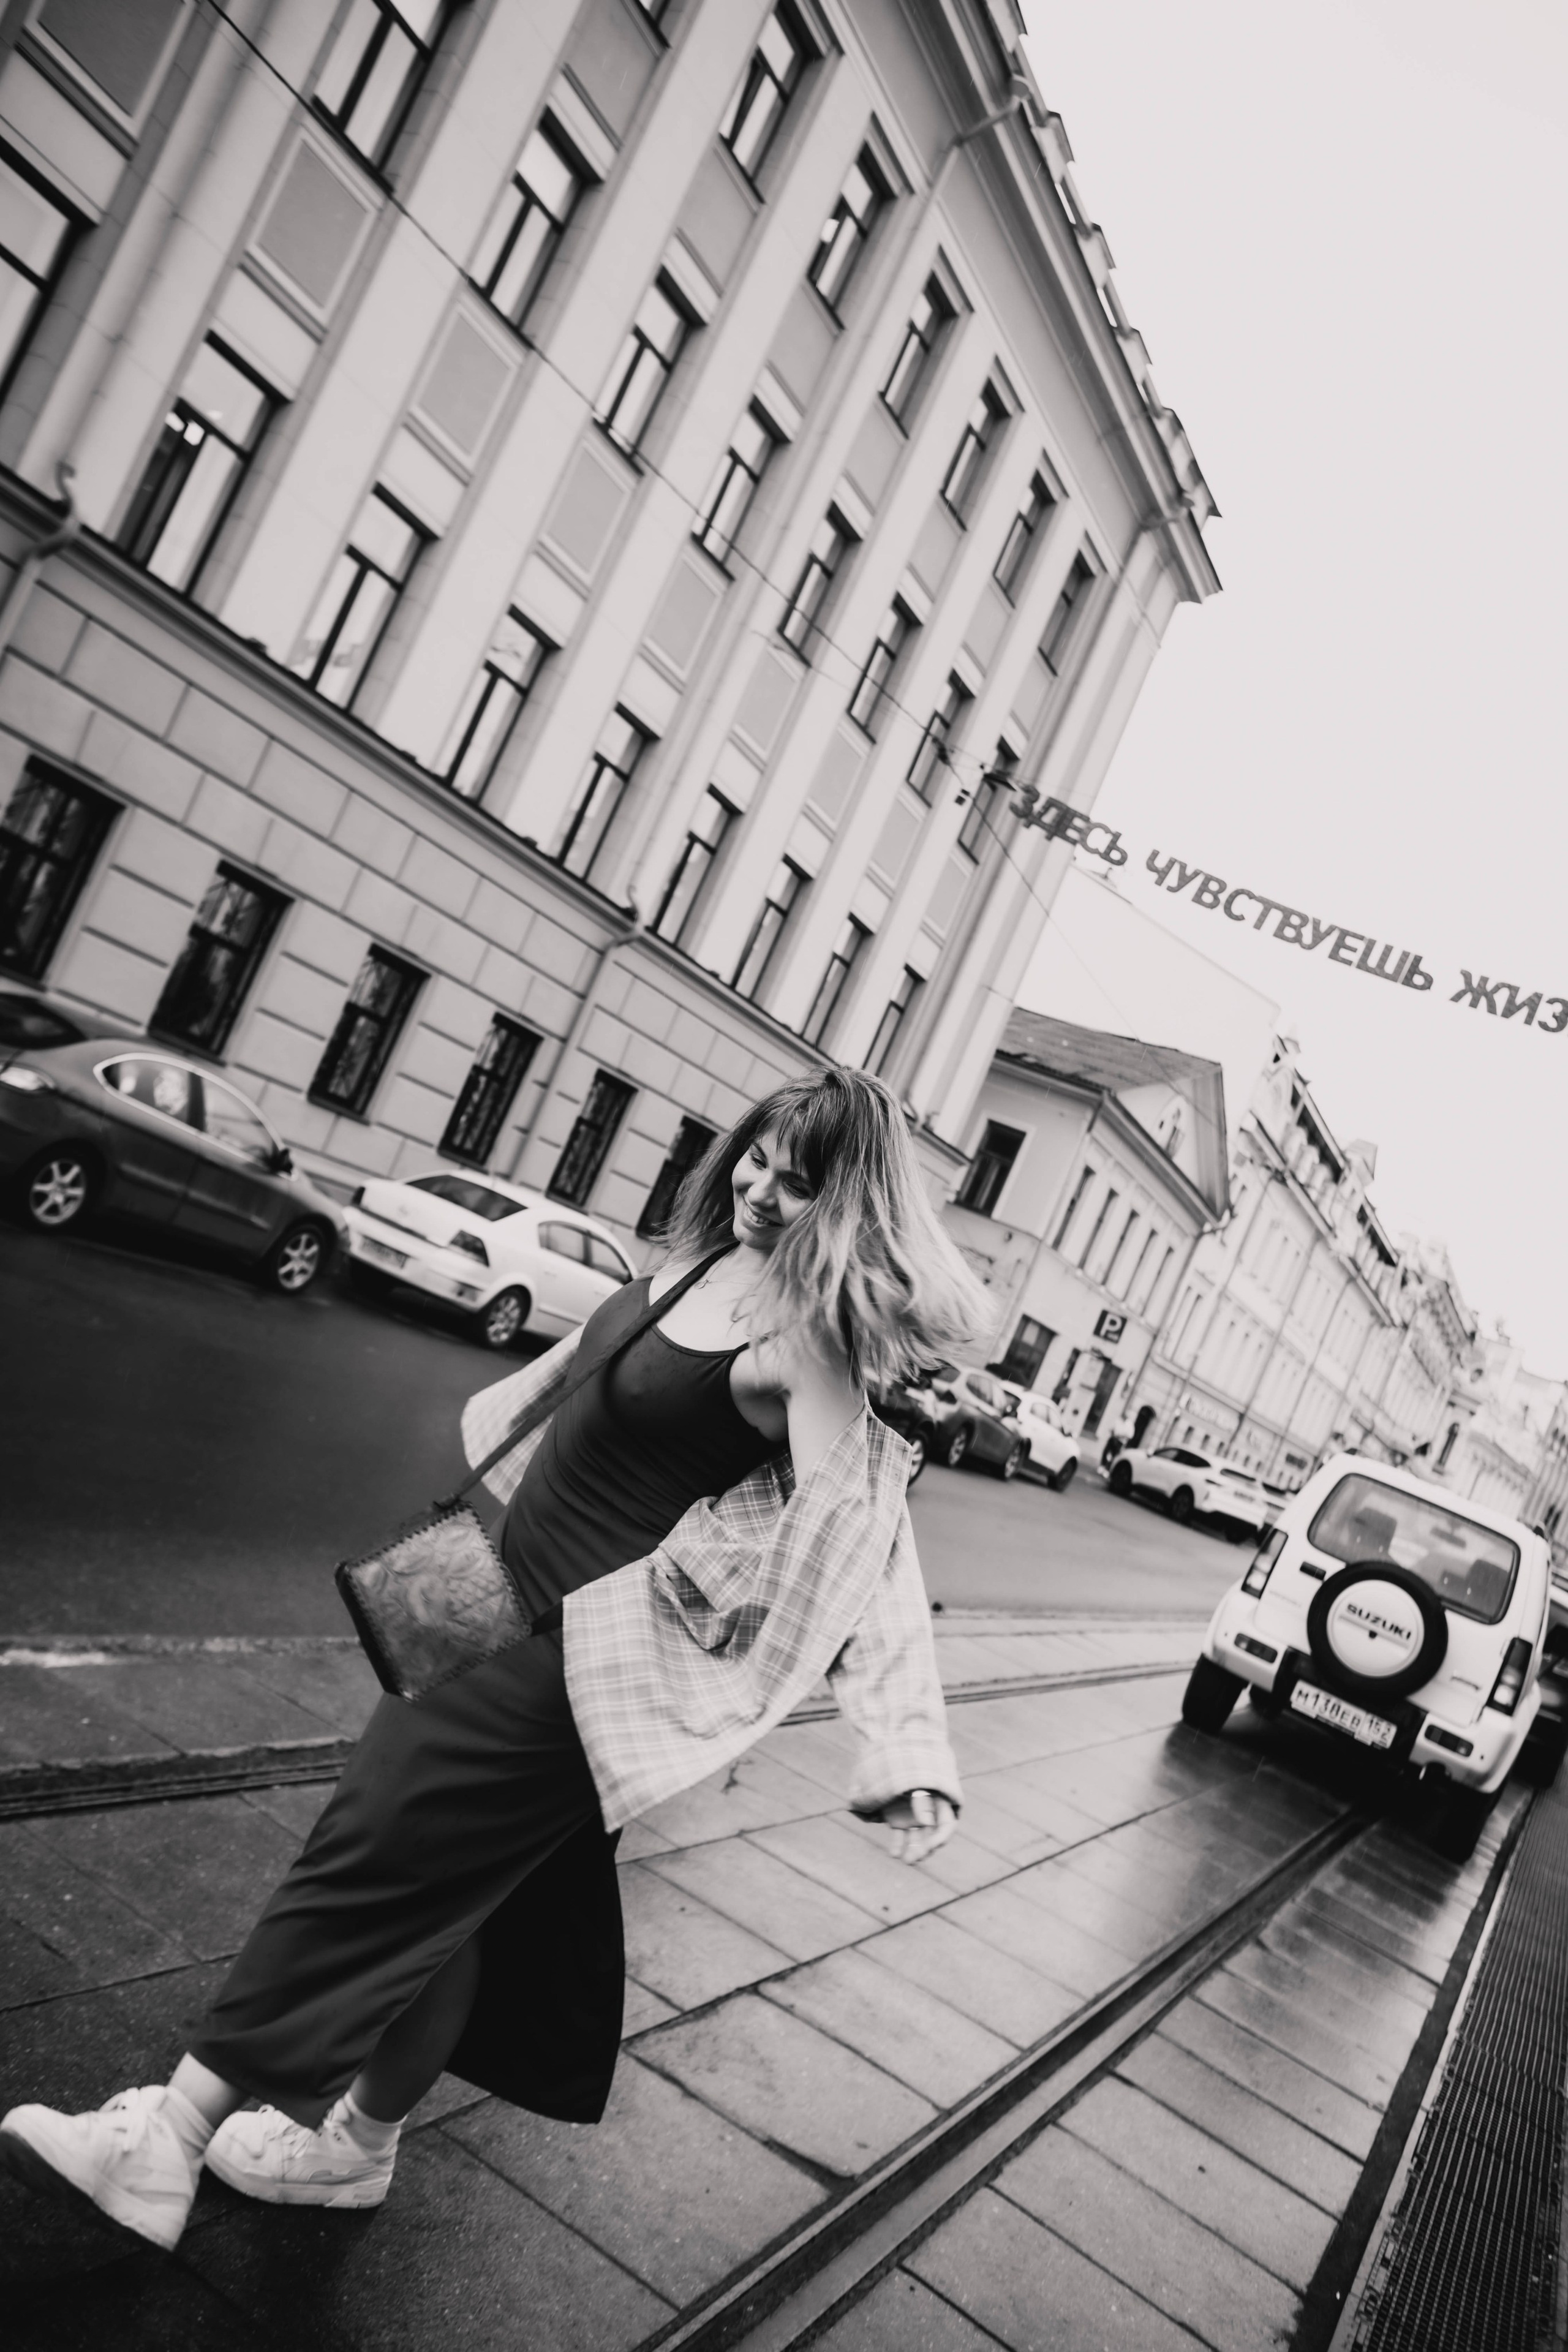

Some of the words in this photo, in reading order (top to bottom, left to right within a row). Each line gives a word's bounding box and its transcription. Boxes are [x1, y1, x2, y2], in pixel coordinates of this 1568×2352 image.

[1009, 785, 1128, 866] ЗДЕСЬ
[1146, 849, 1433, 990] ЧУВСТВУЕШЬ
[1449, 969, 1568, 1033] ЖИЗ
[1099, 1313, 1122, 1337] P
[1347, 1604, 1411, 1640] SUZUKI
